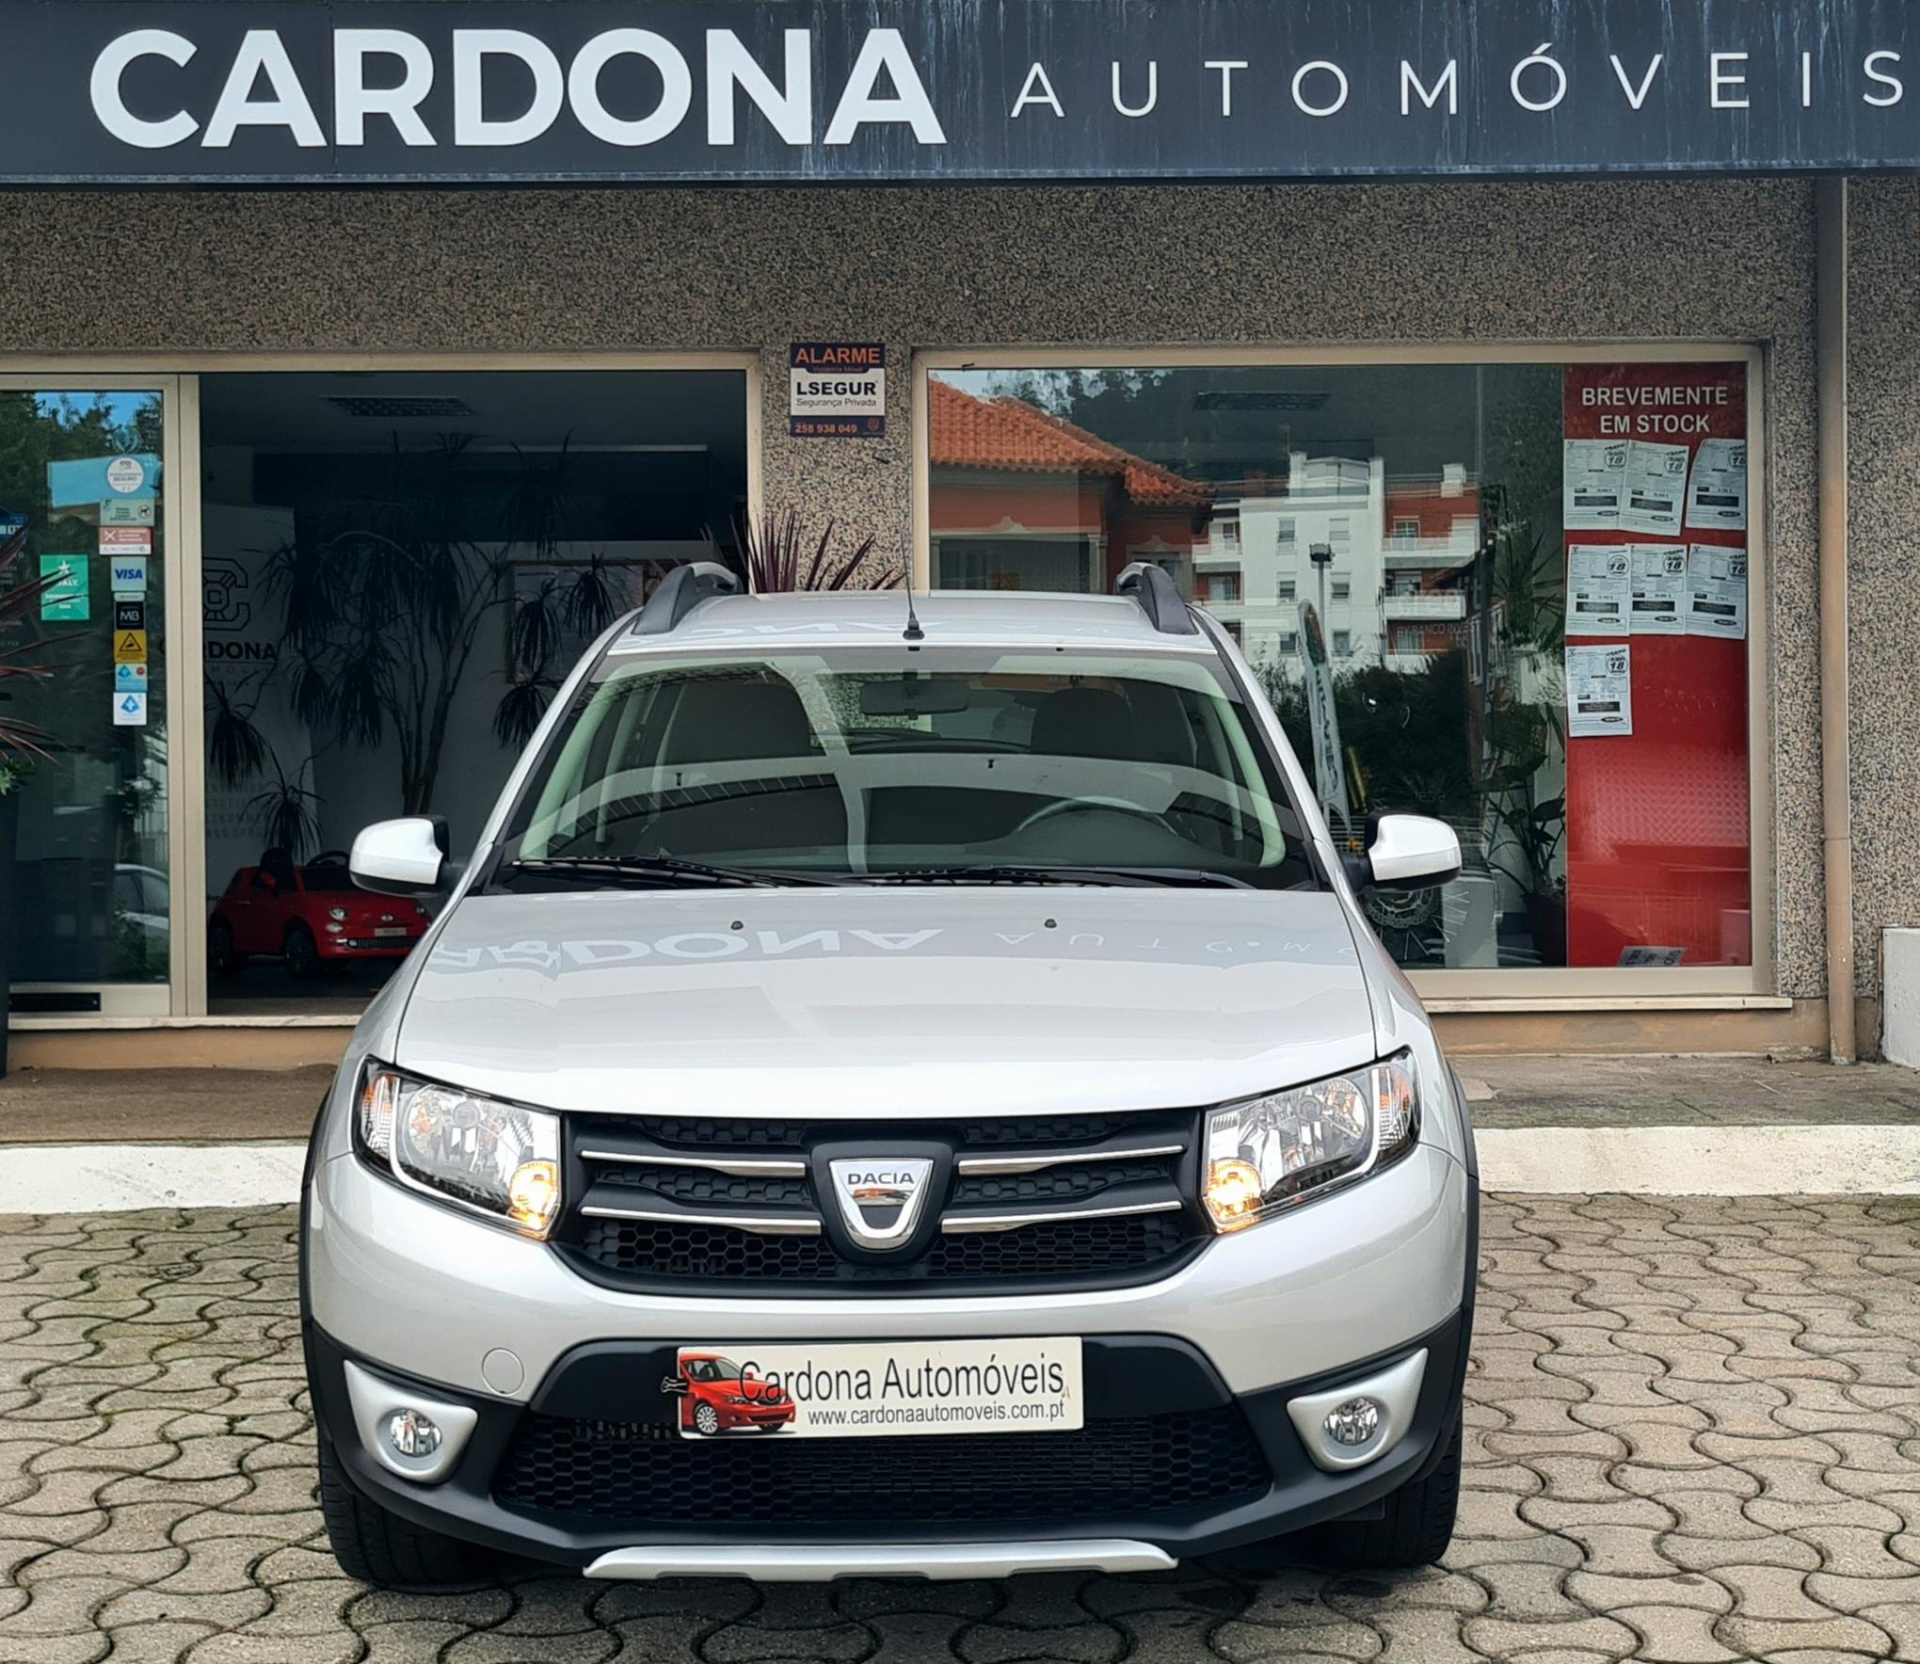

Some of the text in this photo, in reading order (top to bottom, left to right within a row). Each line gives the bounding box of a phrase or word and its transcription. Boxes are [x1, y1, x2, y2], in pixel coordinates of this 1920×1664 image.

[90, 29, 1904, 148] CARDONA AUTOMÓVEIS
[796, 348, 880, 363] ALARME
[796, 381, 877, 396] LSEGUR
[1582, 387, 1728, 405] BREVEMENTE
[796, 398, 876, 408] Segurança Privada
[1600, 415, 1709, 433] EM STOCK
[114, 568, 143, 580] VISA
[119, 610, 140, 621] MB
[847, 1172, 914, 1185] DACIA
[739, 1353, 1065, 1402] Cardona Automóveis
[807, 1400, 1066, 1425] www.cardonaautomoveis.com.pt
